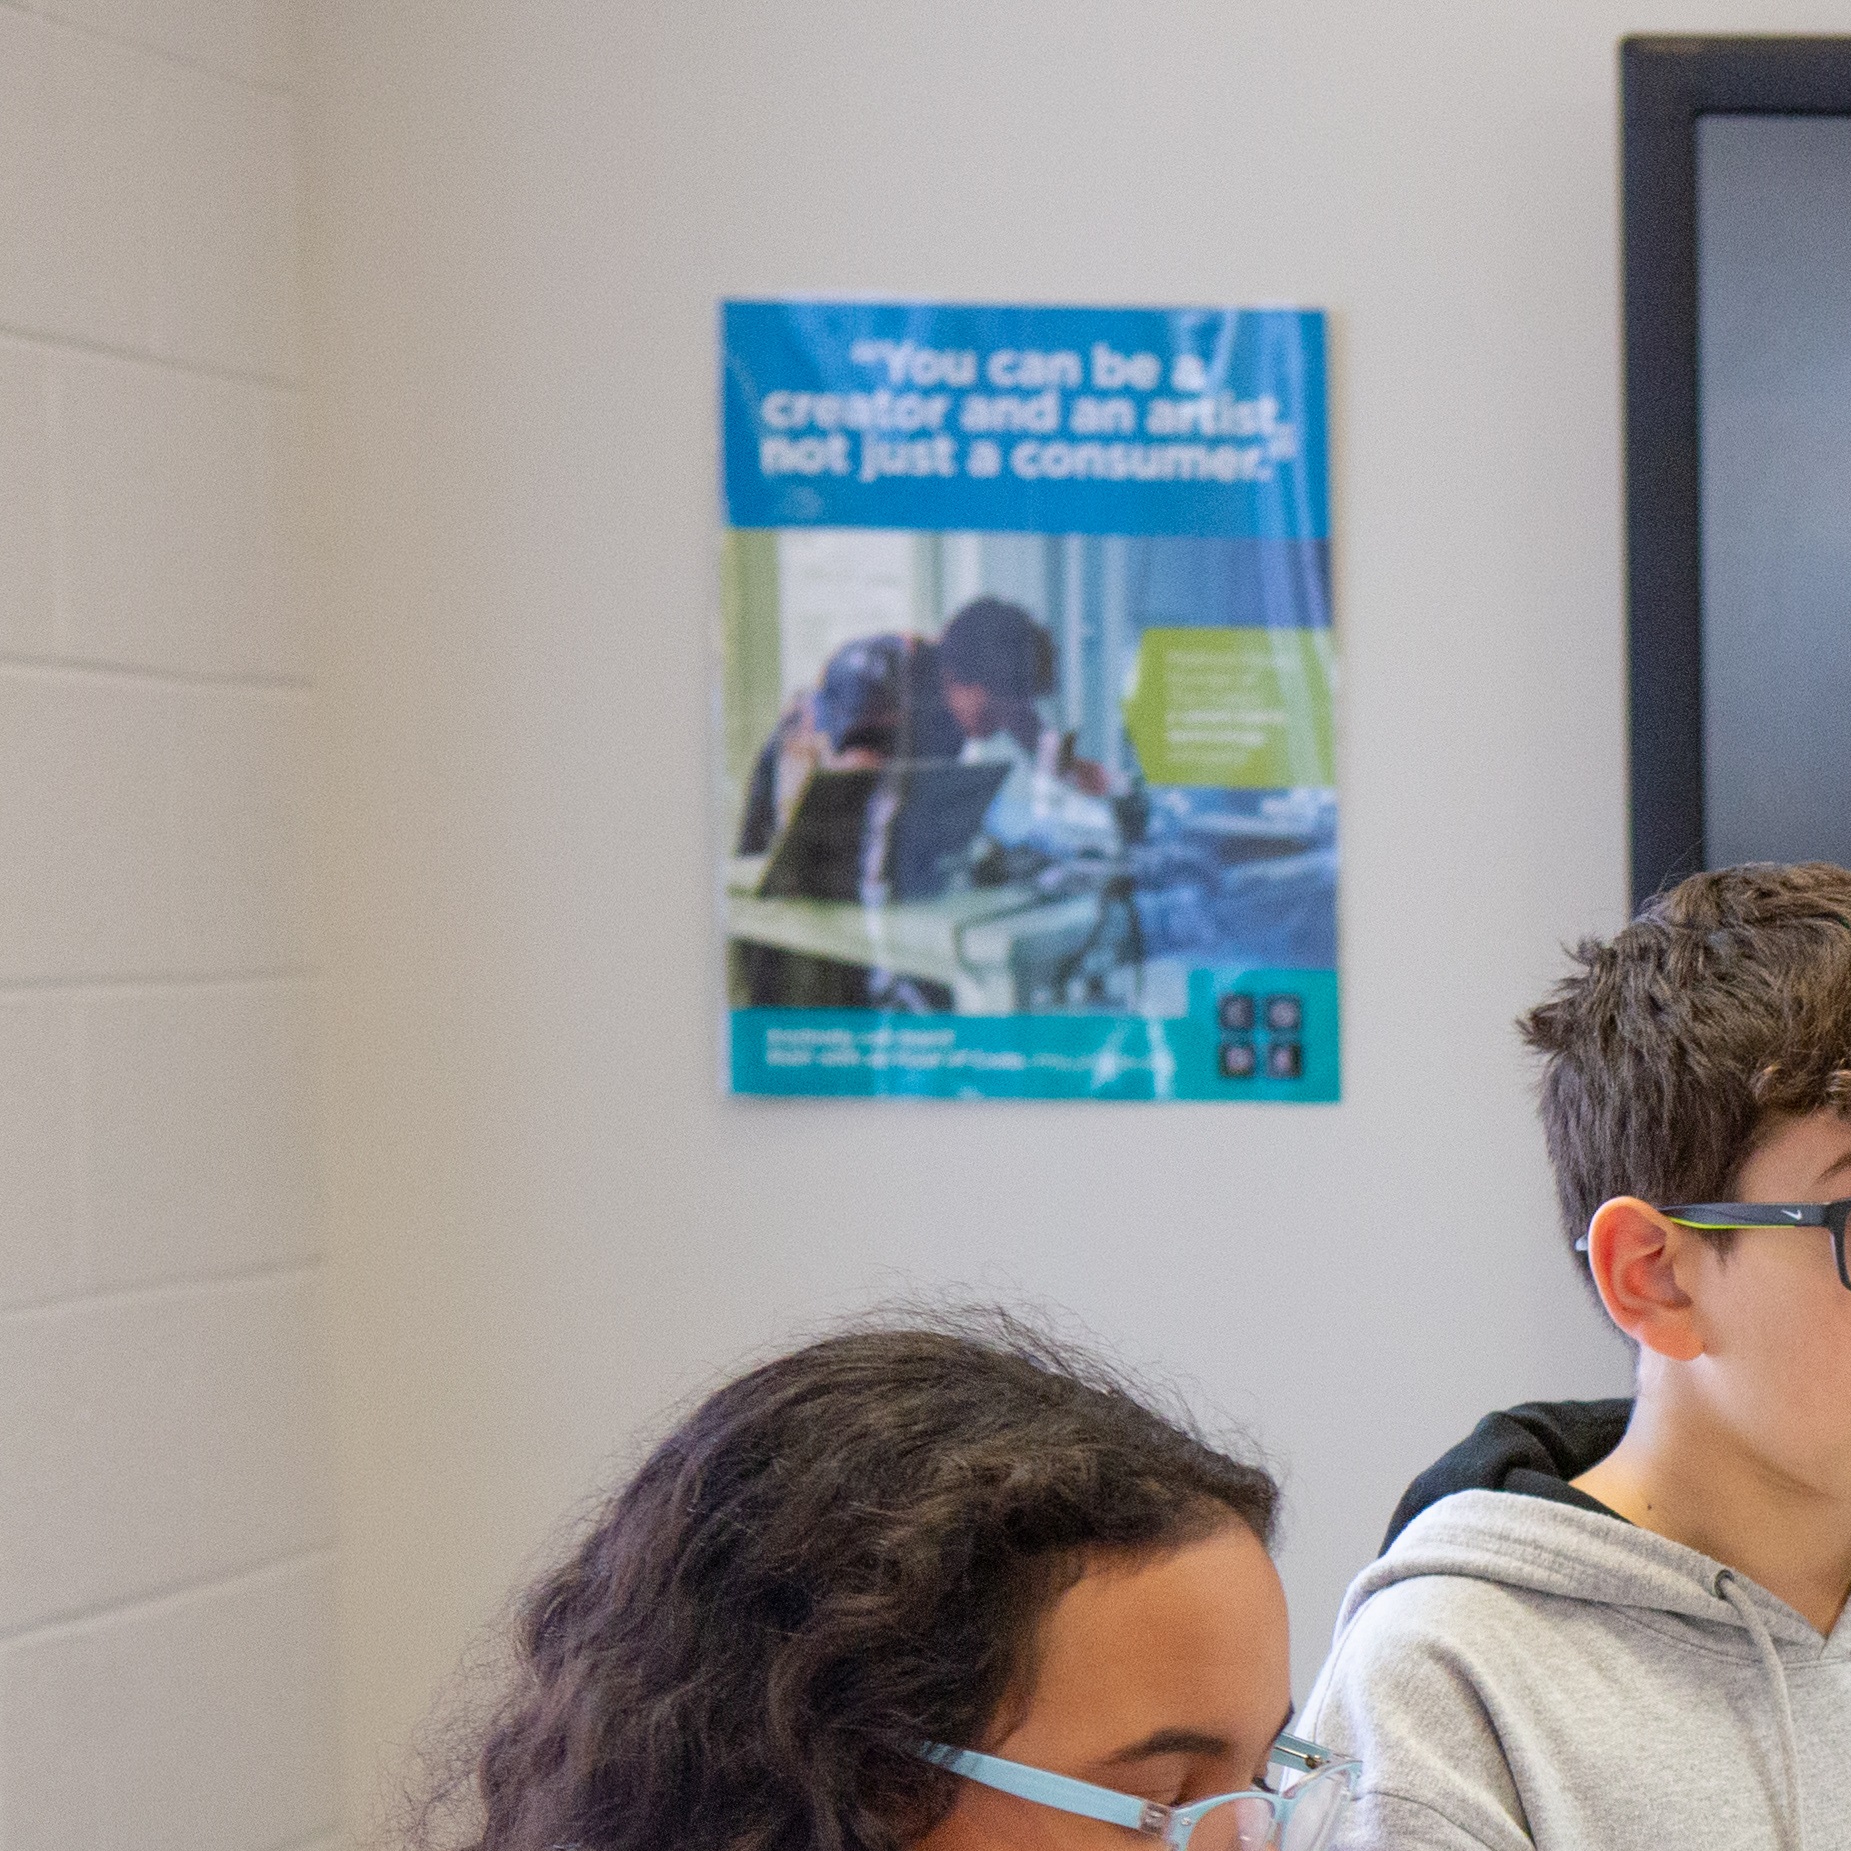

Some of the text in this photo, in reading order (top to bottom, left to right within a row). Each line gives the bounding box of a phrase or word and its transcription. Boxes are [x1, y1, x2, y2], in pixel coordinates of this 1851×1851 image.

[986, 348, 1083, 390] can
[1091, 341, 1161, 390] be
[1171, 354, 1207, 392] a
[759, 388, 952, 431] creator
[960, 388, 1062, 434] and
[1070, 397, 1136, 434] an
[759, 433, 850, 477] not
[858, 434, 955, 482] just
[967, 440, 1002, 478] a
